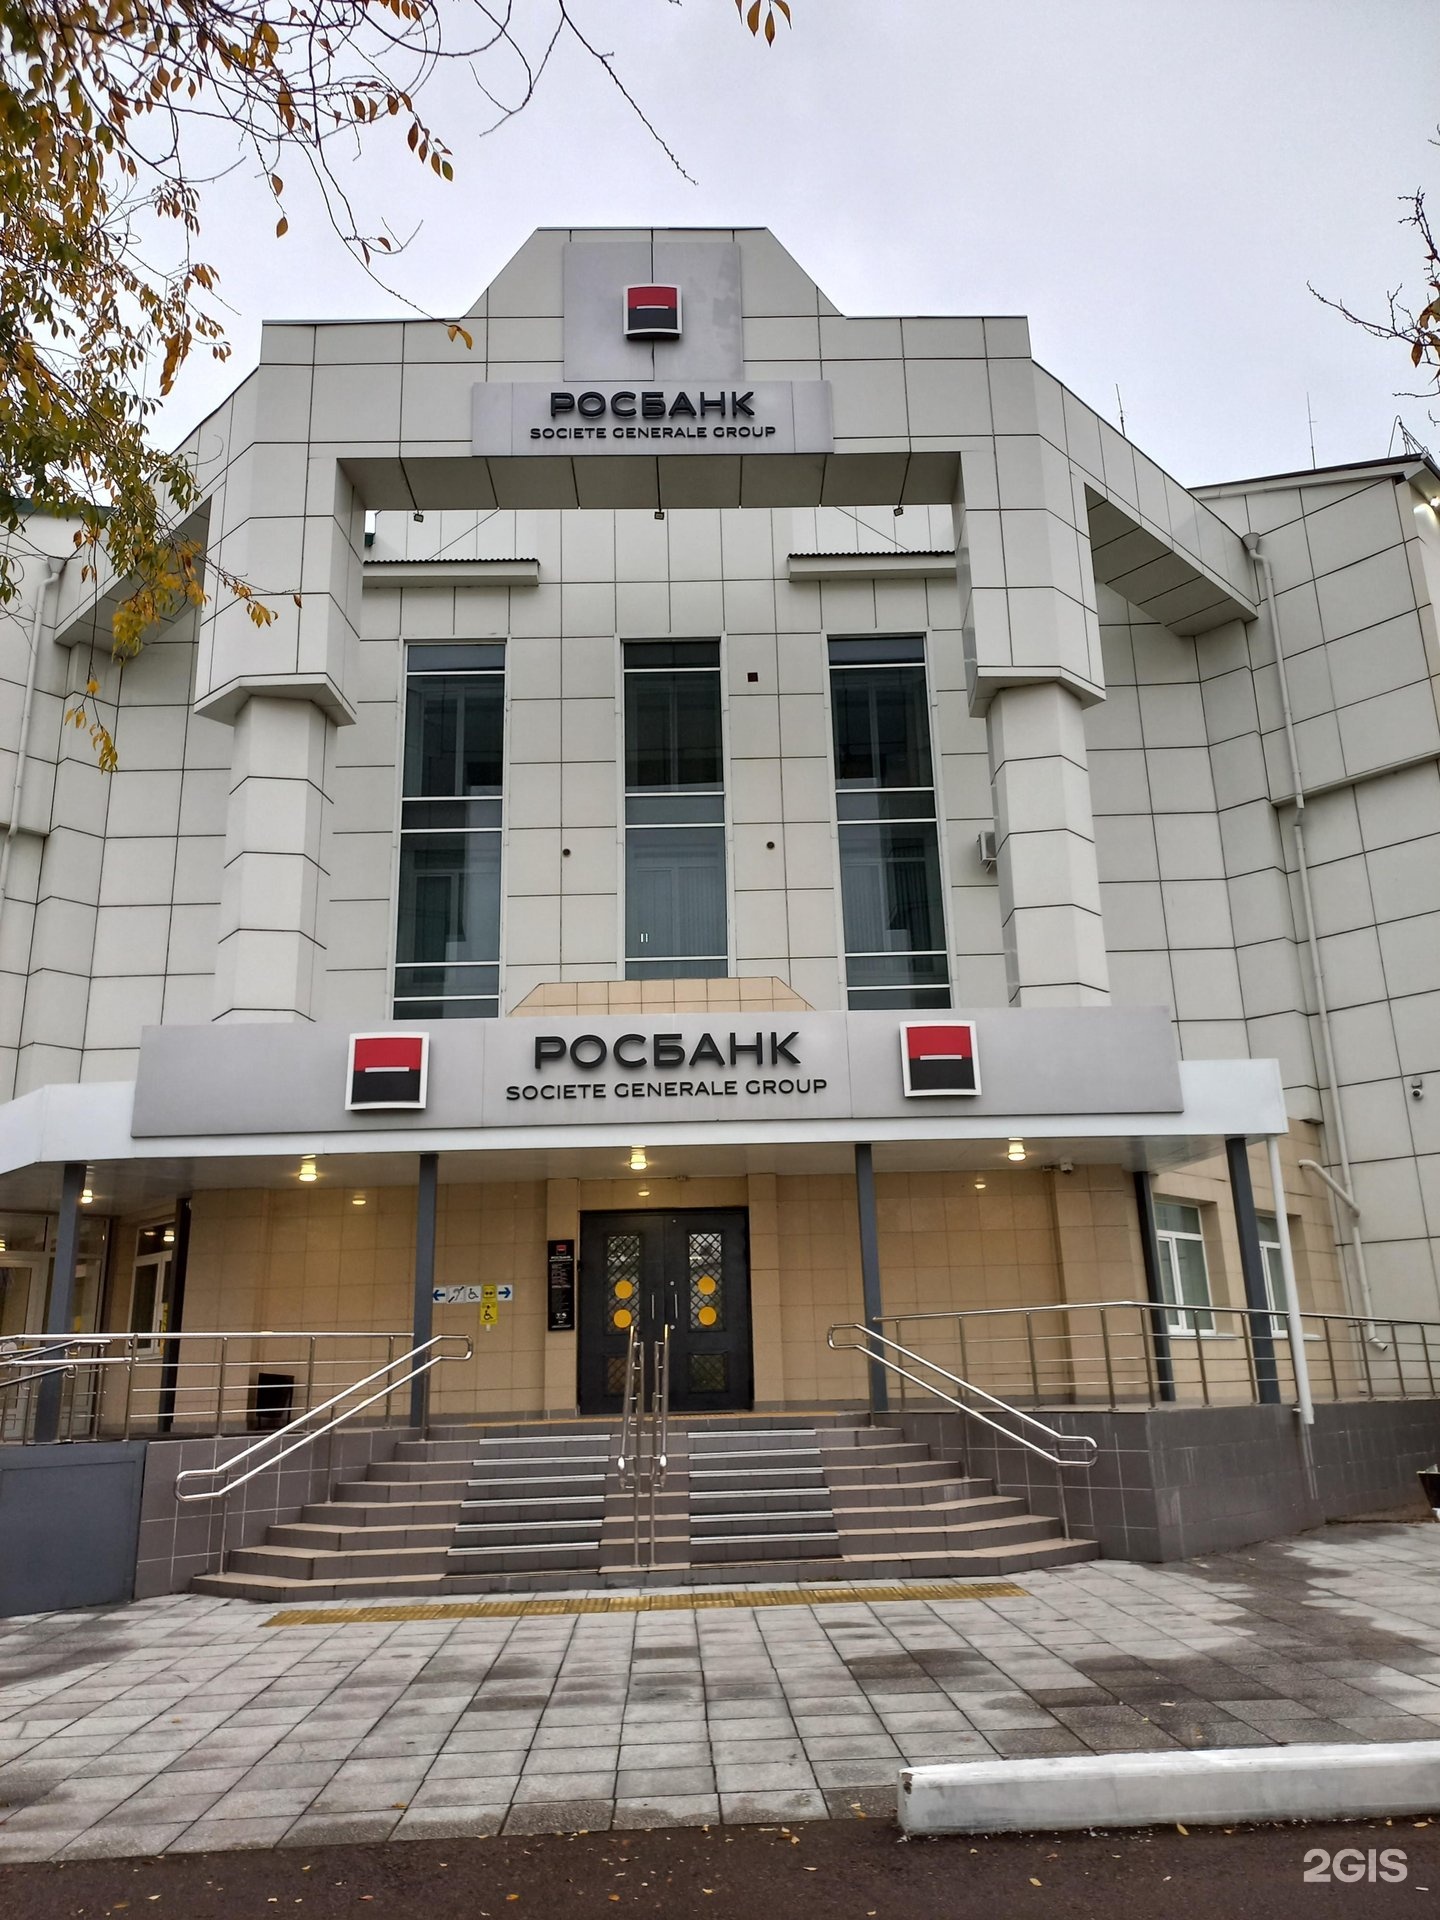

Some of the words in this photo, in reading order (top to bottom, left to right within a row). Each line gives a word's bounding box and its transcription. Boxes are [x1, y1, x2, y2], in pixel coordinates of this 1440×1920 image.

[550, 391, 755, 418] РОСБАНК
[529, 427, 607, 440] SOCIETE
[612, 426, 708, 440] GENERALE
[712, 426, 776, 439] GROUP
[534, 1031, 801, 1070] РОСБАНК
[506, 1083, 607, 1102] SOCIETE
[614, 1080, 738, 1099] GENERALE
[745, 1078, 828, 1096] GROUP
